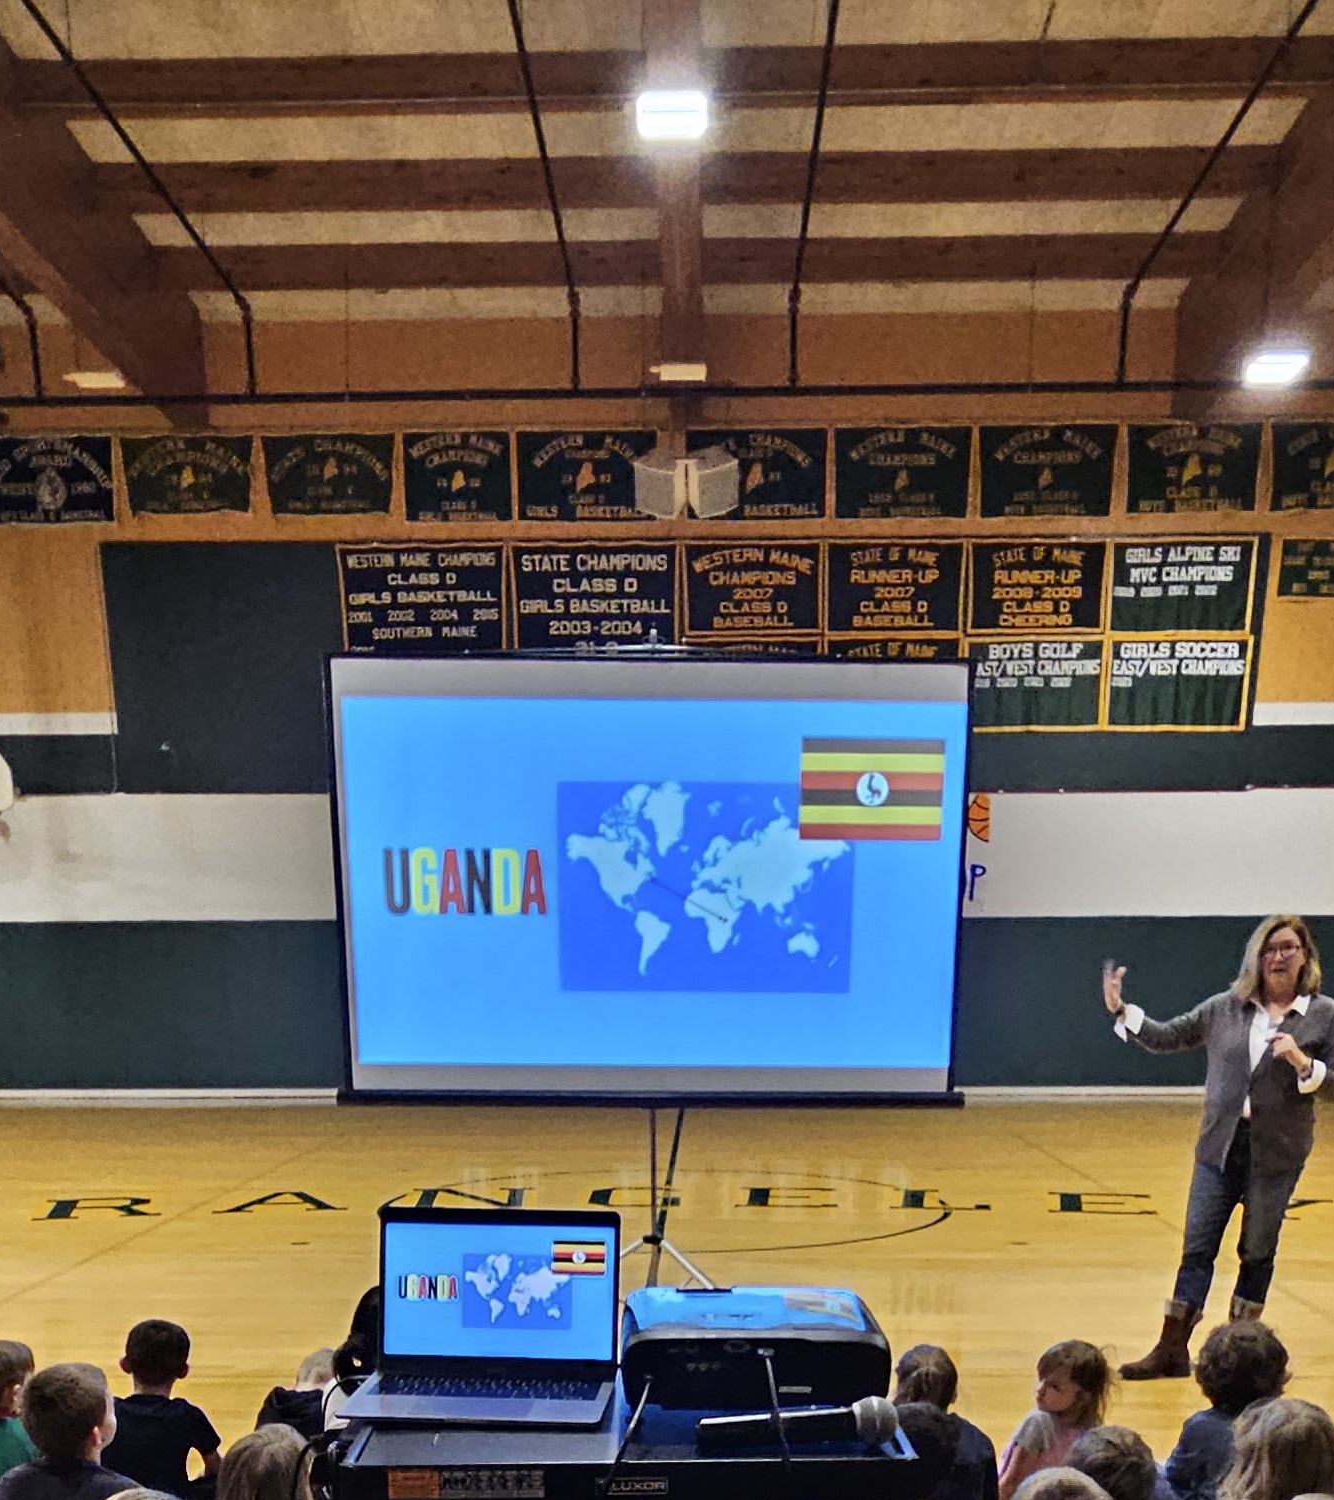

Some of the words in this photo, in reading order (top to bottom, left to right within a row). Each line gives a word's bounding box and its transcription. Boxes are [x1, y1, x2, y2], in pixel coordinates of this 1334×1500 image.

[743, 504, 818, 517] BASKETBALL
[346, 552, 396, 569] WESTERN
[400, 552, 432, 568] MAINE
[437, 551, 497, 567] CHAMPIONS
[521, 554, 571, 572] STATE
[576, 553, 668, 572] CHAMPIONS
[692, 548, 764, 574] WESTERN
[769, 549, 815, 575] MAINE
[1126, 547, 1163, 563] GIRLS
[1167, 546, 1215, 562] ALPINE
[1218, 546, 1242, 562] SKI
[387, 573, 441, 586] CLASS
[446, 573, 457, 585] D
[708, 570, 797, 586] CHAMPIONS
[850, 570, 940, 584] RUNNER-UP
[994, 570, 1083, 584] RUNNER-UP
[1129, 567, 1158, 584] MVC
[1162, 566, 1234, 582] CHAMPIONS
[553, 578, 617, 593] CLASS
[624, 577, 639, 593] D
[348, 592, 392, 606] GIRLS
[397, 590, 498, 604] BASKETBALL
[520, 600, 566, 614] GIRLS
[570, 599, 672, 614] BASKETBALL
[718, 602, 772, 614] CLASS
[776, 601, 788, 614] D
[859, 602, 912, 614] CLASS
[916, 601, 928, 614] D
[1002, 601, 1055, 614] CLASS
[1060, 601, 1071, 614] D
[549, 620, 643, 636] 2003-2004
[713, 615, 795, 629] BASEBALL
[852, 615, 935, 628] BASEBALL
[998, 615, 1073, 627] CHEERING
[372, 626, 433, 641] SOUTHERN
[441, 625, 478, 638] MAINE
[988, 643, 1034, 660] BOYS
[1039, 643, 1085, 659] GOLF
[1120, 643, 1171, 659] GIRLS
[1175, 642, 1240, 659] SOCCER
[975, 660, 1037, 678] AST/WEST
[1038, 659, 1101, 676] CHAMPIONS
[1112, 660, 1179, 678] EAST/WEST
[1181, 659, 1246, 676] CHAMPIONS
[383, 847, 547, 916] UGANDA
[398, 1274, 460, 1302] UGANDA
[612, 1480, 666, 1493] LUXOR
